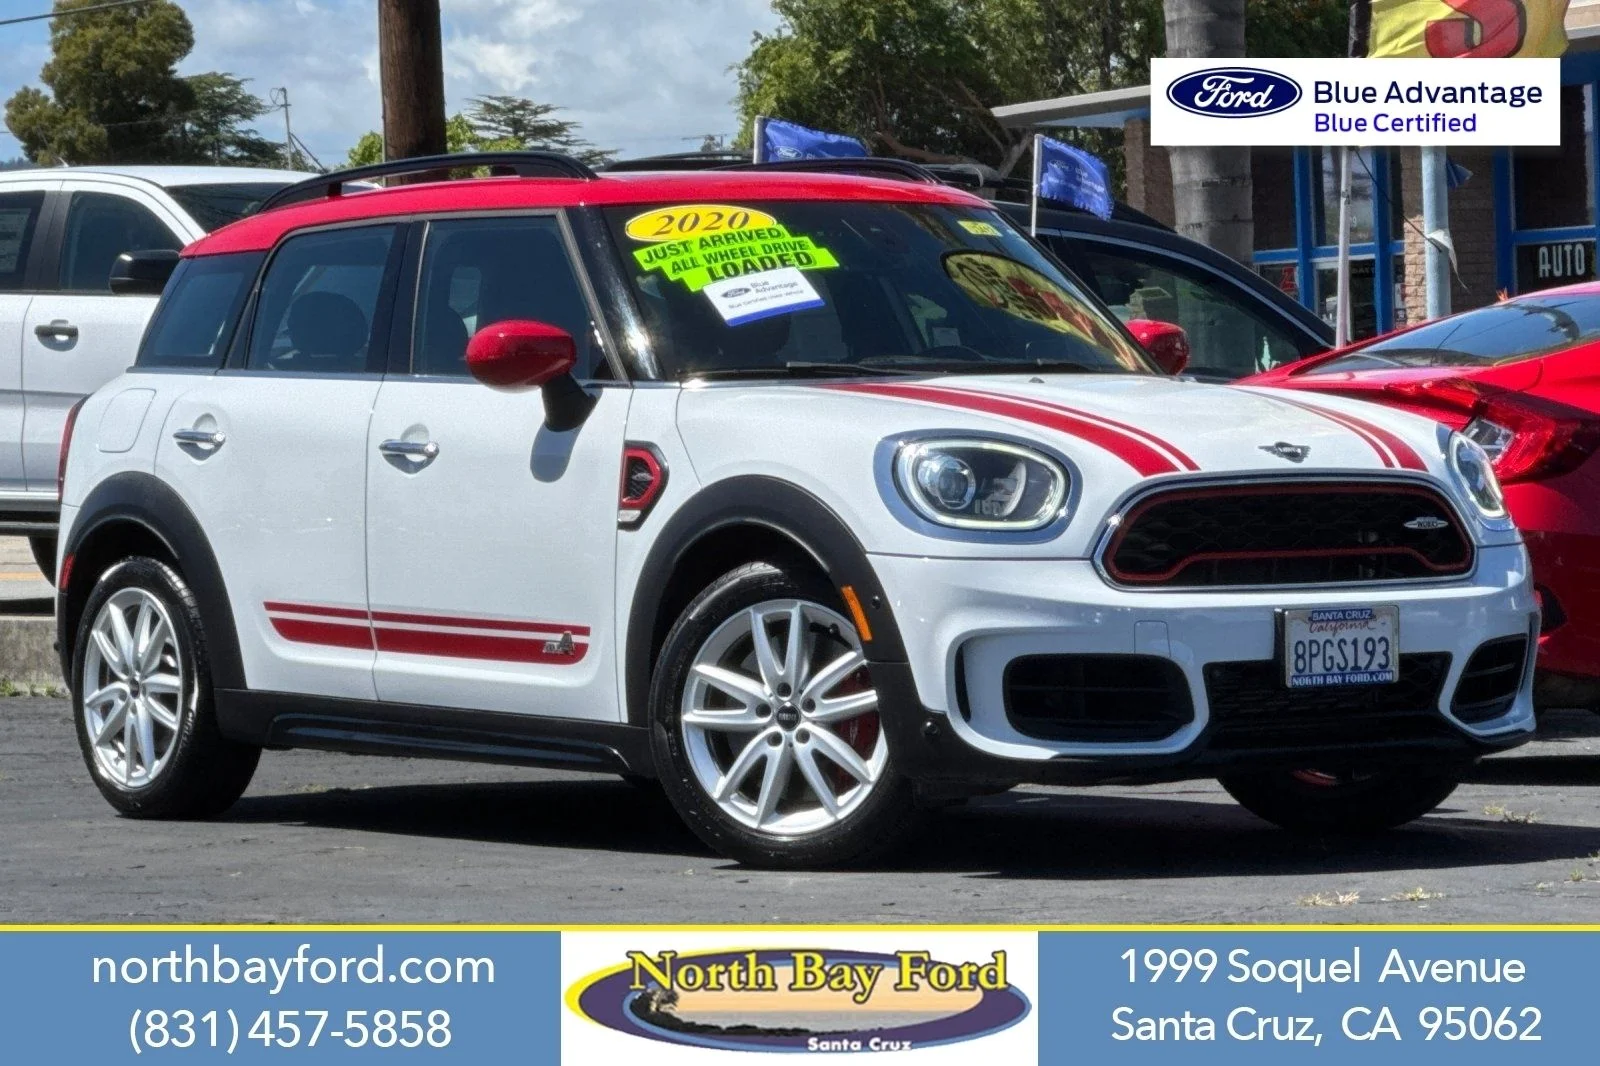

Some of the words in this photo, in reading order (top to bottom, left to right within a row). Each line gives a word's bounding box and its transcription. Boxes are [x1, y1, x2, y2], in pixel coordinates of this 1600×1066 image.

[651, 211, 751, 237] 2020
[643, 240, 690, 265] JUST
[698, 227, 783, 251] ARRIVED
[671, 258, 699, 276] ALL
[702, 245, 757, 266] WHEEL
[764, 239, 810, 256] DRIVE
[705, 251, 815, 282] LOADED
[1539, 243, 1586, 278] AUTO
[755, 281, 799, 294] Advantage
[1309, 620, 1377, 637] California
[1312, 610, 1344, 621] SANTA
[1345, 609, 1372, 620] CRUZ
[1294, 636, 1390, 674] 8PGS193
[1291, 675, 1325, 687] NORTH
[1326, 674, 1344, 685] BAY
[1345, 671, 1393, 683] FORD.COM
